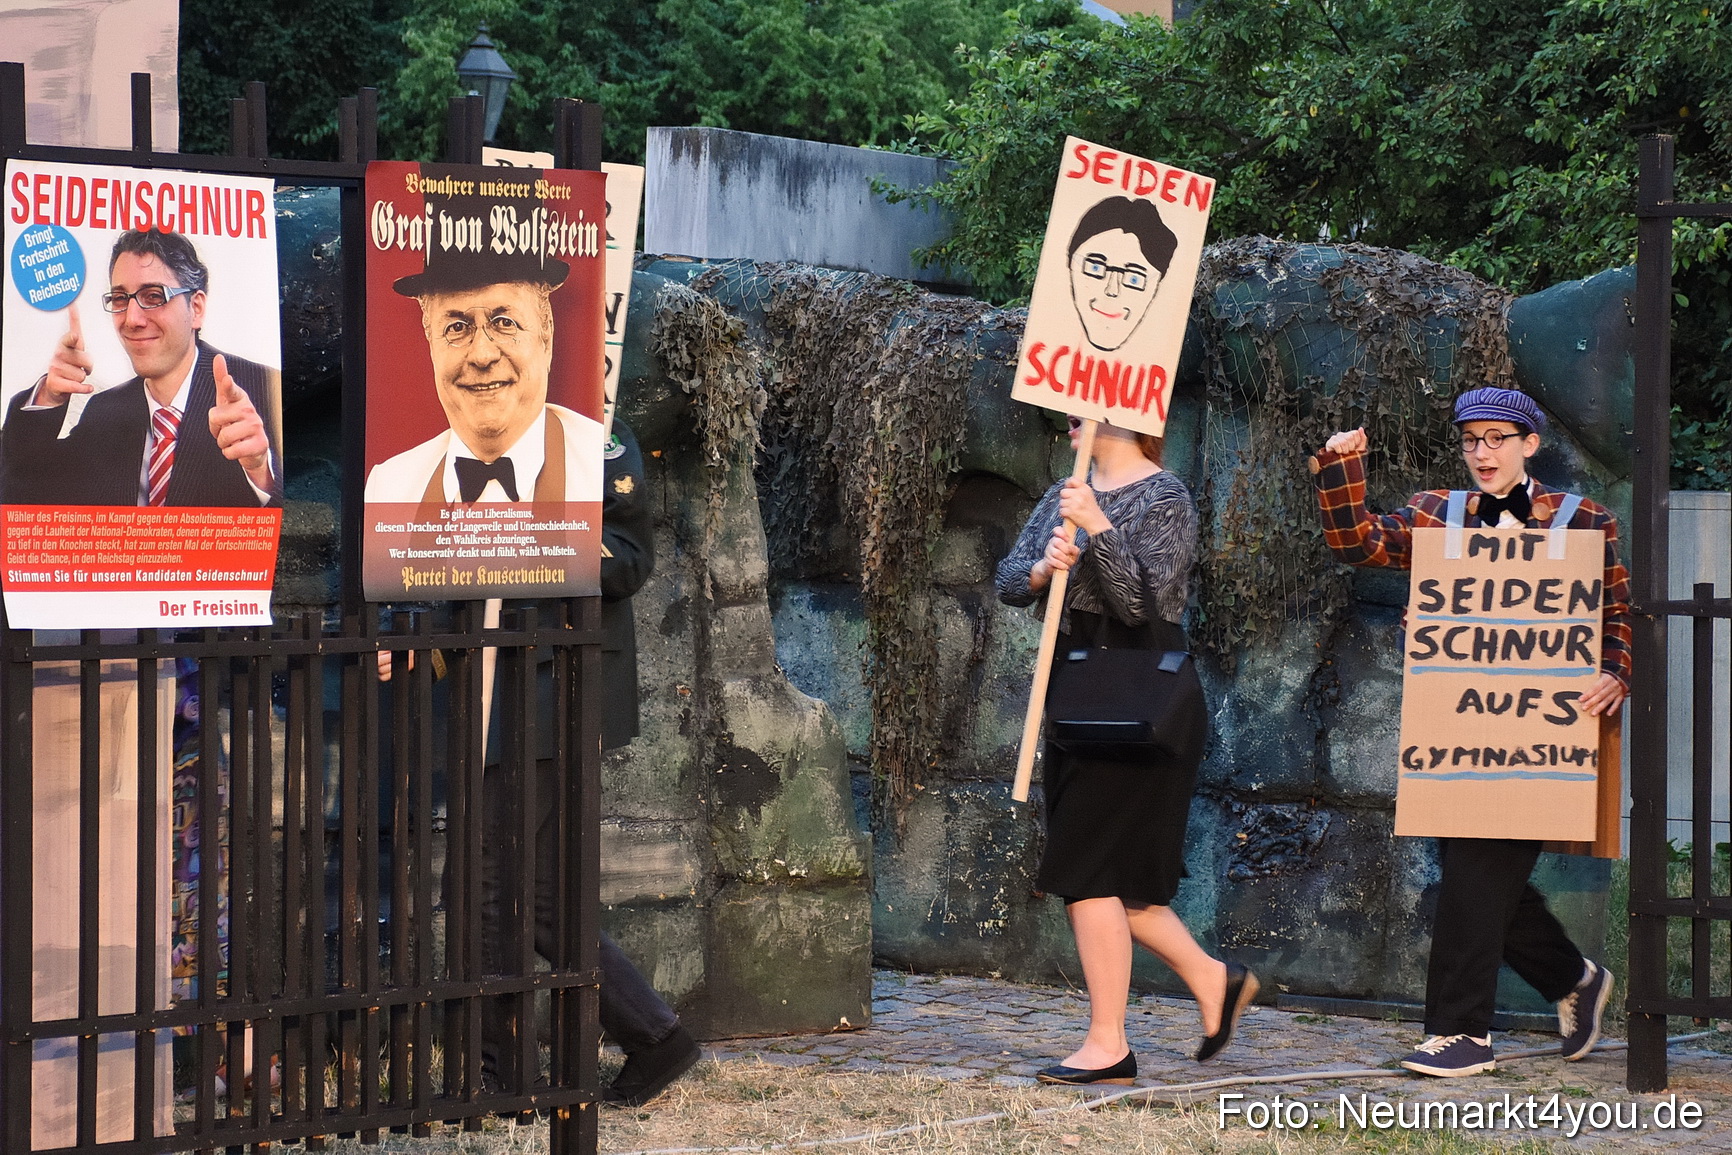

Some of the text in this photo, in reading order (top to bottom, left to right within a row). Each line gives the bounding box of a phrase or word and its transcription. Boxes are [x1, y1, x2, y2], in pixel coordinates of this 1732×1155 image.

[405, 172, 572, 200] Bewahrer unserer Werte
[1066, 144, 1212, 212] SEIDEN
[11, 171, 267, 239] SEIDENSCHNUR
[24, 226, 55, 248] Bringt
[370, 199, 434, 267] Graf
[439, 209, 483, 252] von
[489, 204, 599, 271] Wolfstein
[19, 239, 70, 269] Fortschritt
[34, 262, 65, 283] in den
[29, 273, 80, 304] Reichstag!
[1023, 341, 1167, 422] SCHNUR
[7, 511, 276, 526] Wähler des Freisinns, im Kampf gegen den Absolutismus, aber auch
[375, 520, 590, 534] diesem Drachen der Langeweile und Unentschiedenheit,
[440, 508, 534, 521] Es gilt dem Liberalismus,
[7, 525, 274, 539] gegen die Lauheit der National-Demokraten, denen der preußische Drill
[7, 539, 273, 552] zu tief in den Knochen steckt, hat zum ersten Mal der fortschrittliche
[435, 534, 537, 546] den Wahlkreis abzuringen.
[7, 553, 183, 566] Geist die Chance, in den Reichstag einzuziehen.
[389, 546, 576, 558] Wer konservativ denkt und fühlt, wählt Wolfstein.
[1468, 533, 1545, 562] MIT
[8, 569, 268, 582] Stimmen Sie für unseren Kandidaten Seidenschnur!
[401, 564, 565, 592] Partei der Konservativen
[159, 599, 264, 617] Der Freisinn.
[1418, 577, 1603, 615] SEIDEN
[1409, 625, 1596, 665] SCHNUR
[1456, 688, 1584, 726] AUFS
[1401, 744, 1598, 771] GYMNASIUM
